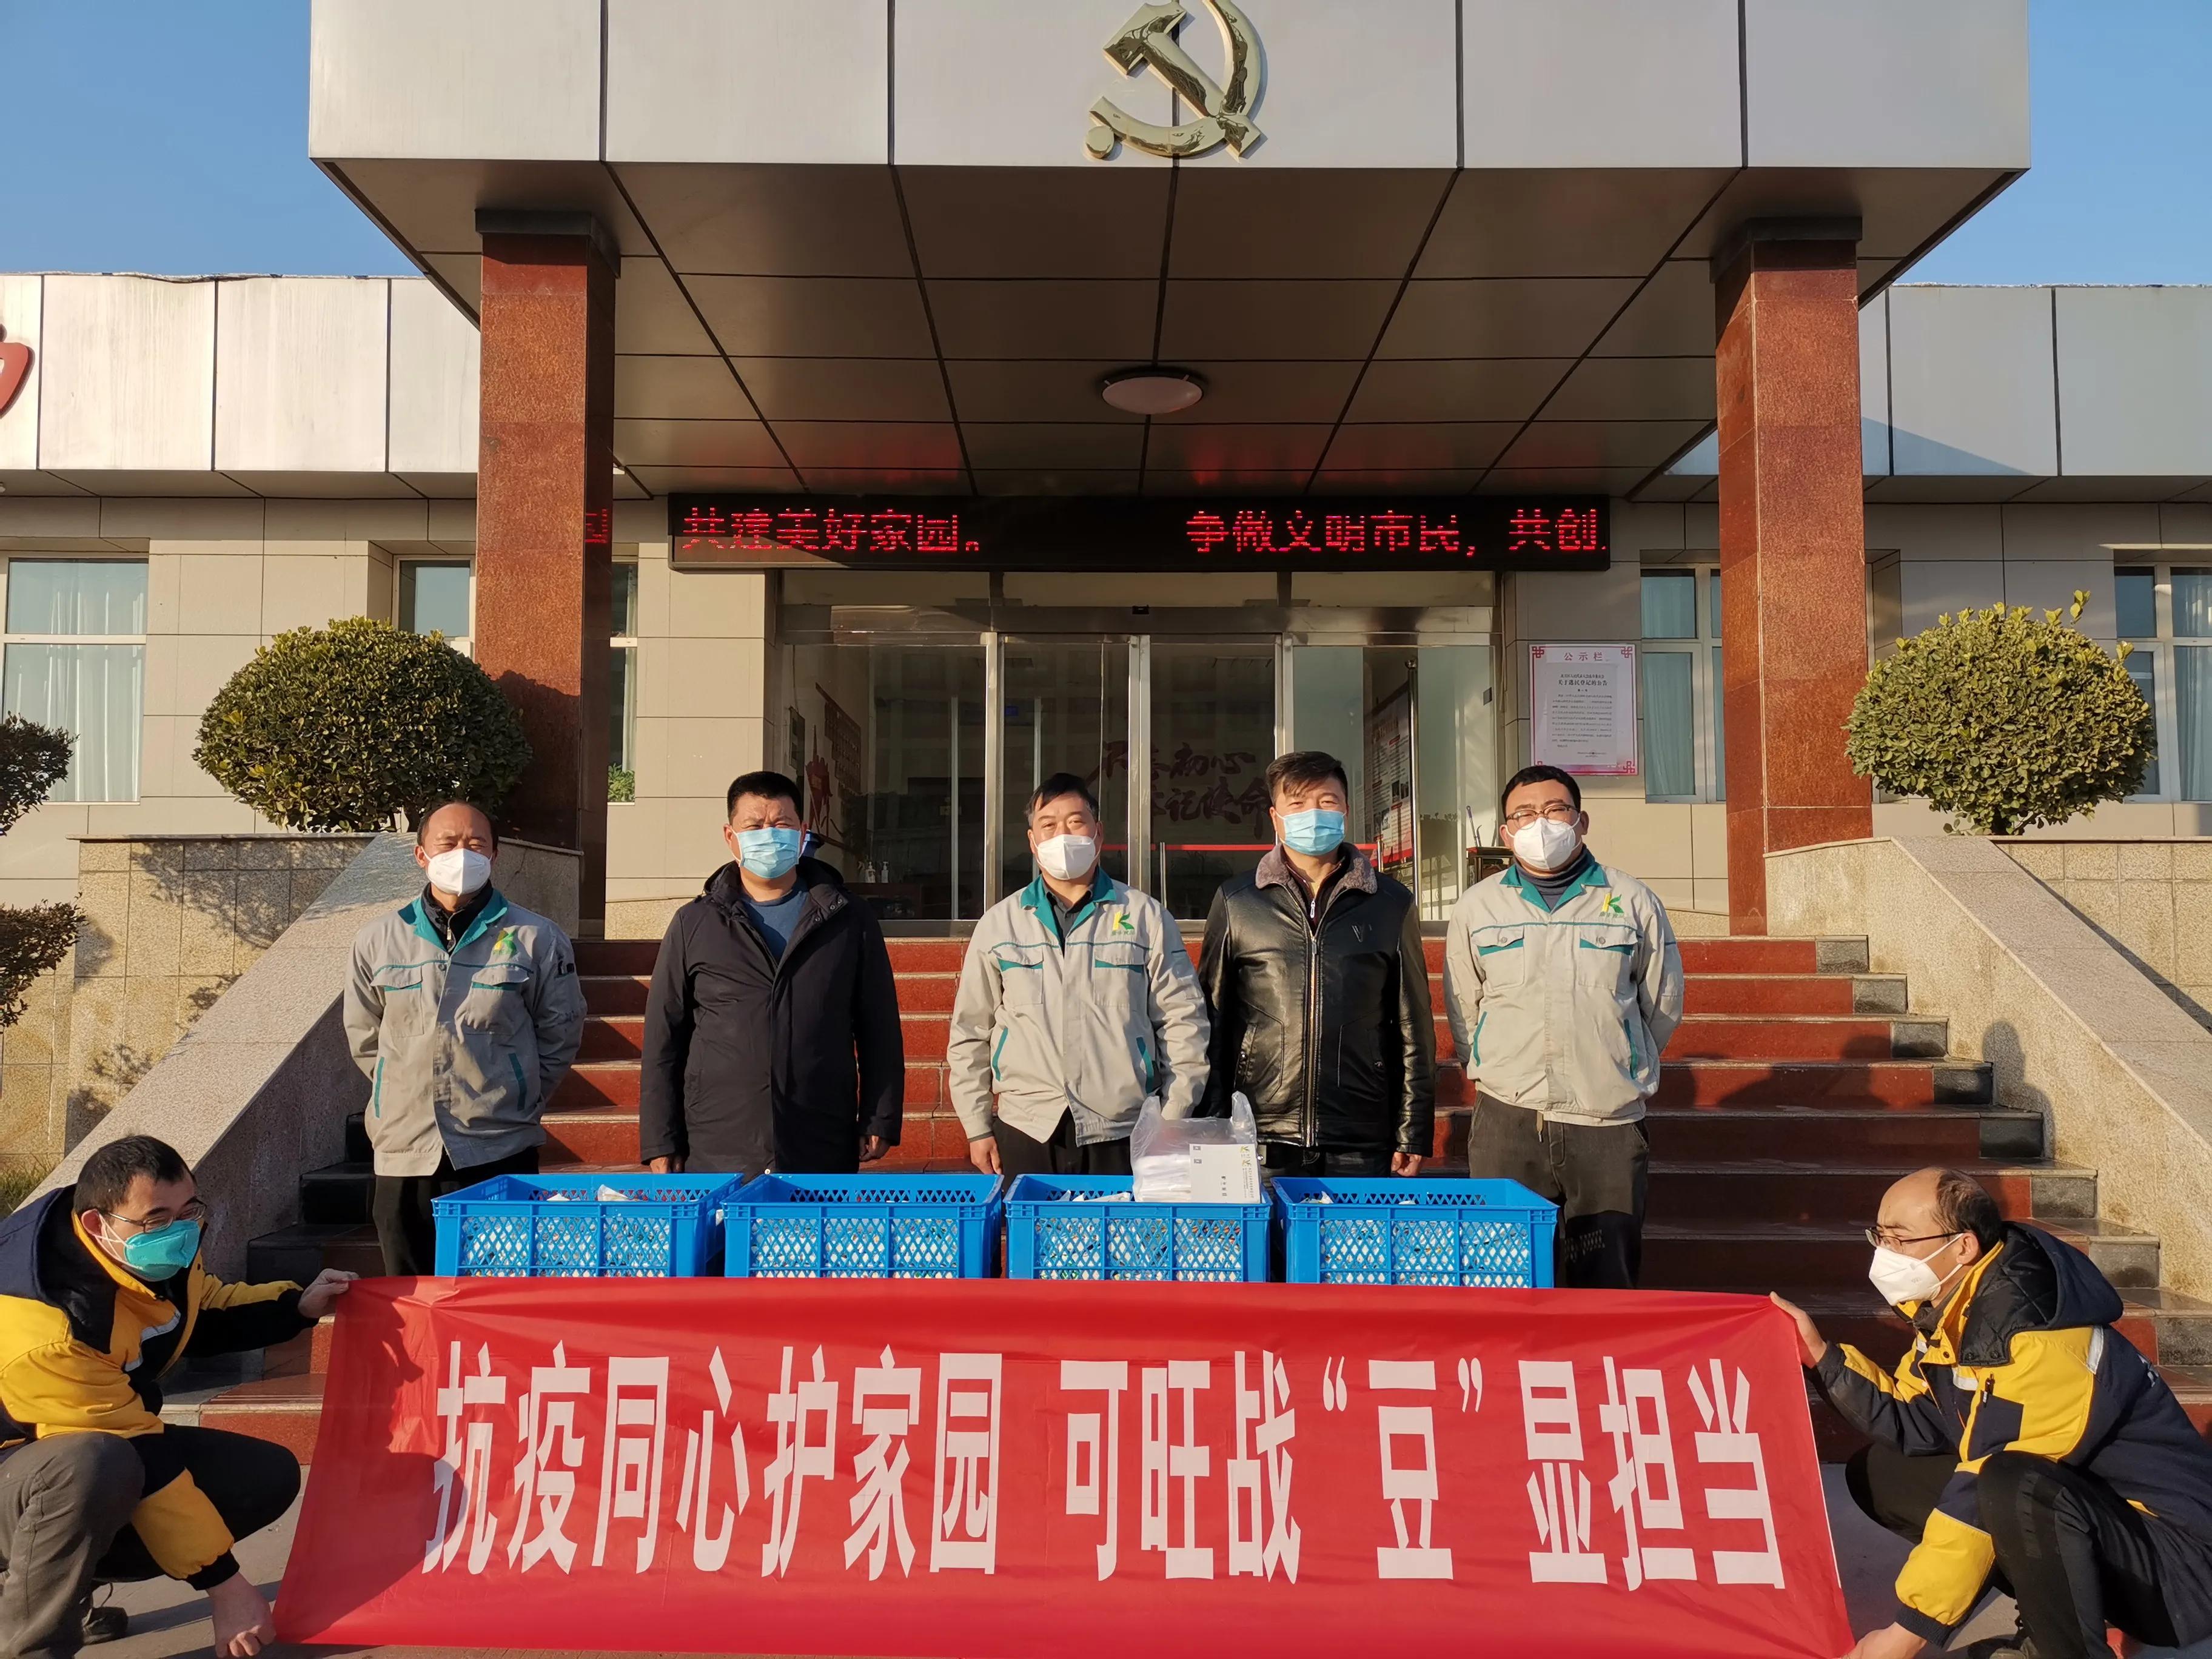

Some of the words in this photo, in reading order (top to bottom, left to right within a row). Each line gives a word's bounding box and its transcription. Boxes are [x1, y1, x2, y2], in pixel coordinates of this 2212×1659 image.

[1563, 651, 1603, 662] 公示栏
[421, 1340, 1002, 1581] 抗疫同心护家园
[1060, 1350, 1786, 1591] 可旺战“豆”显担当
